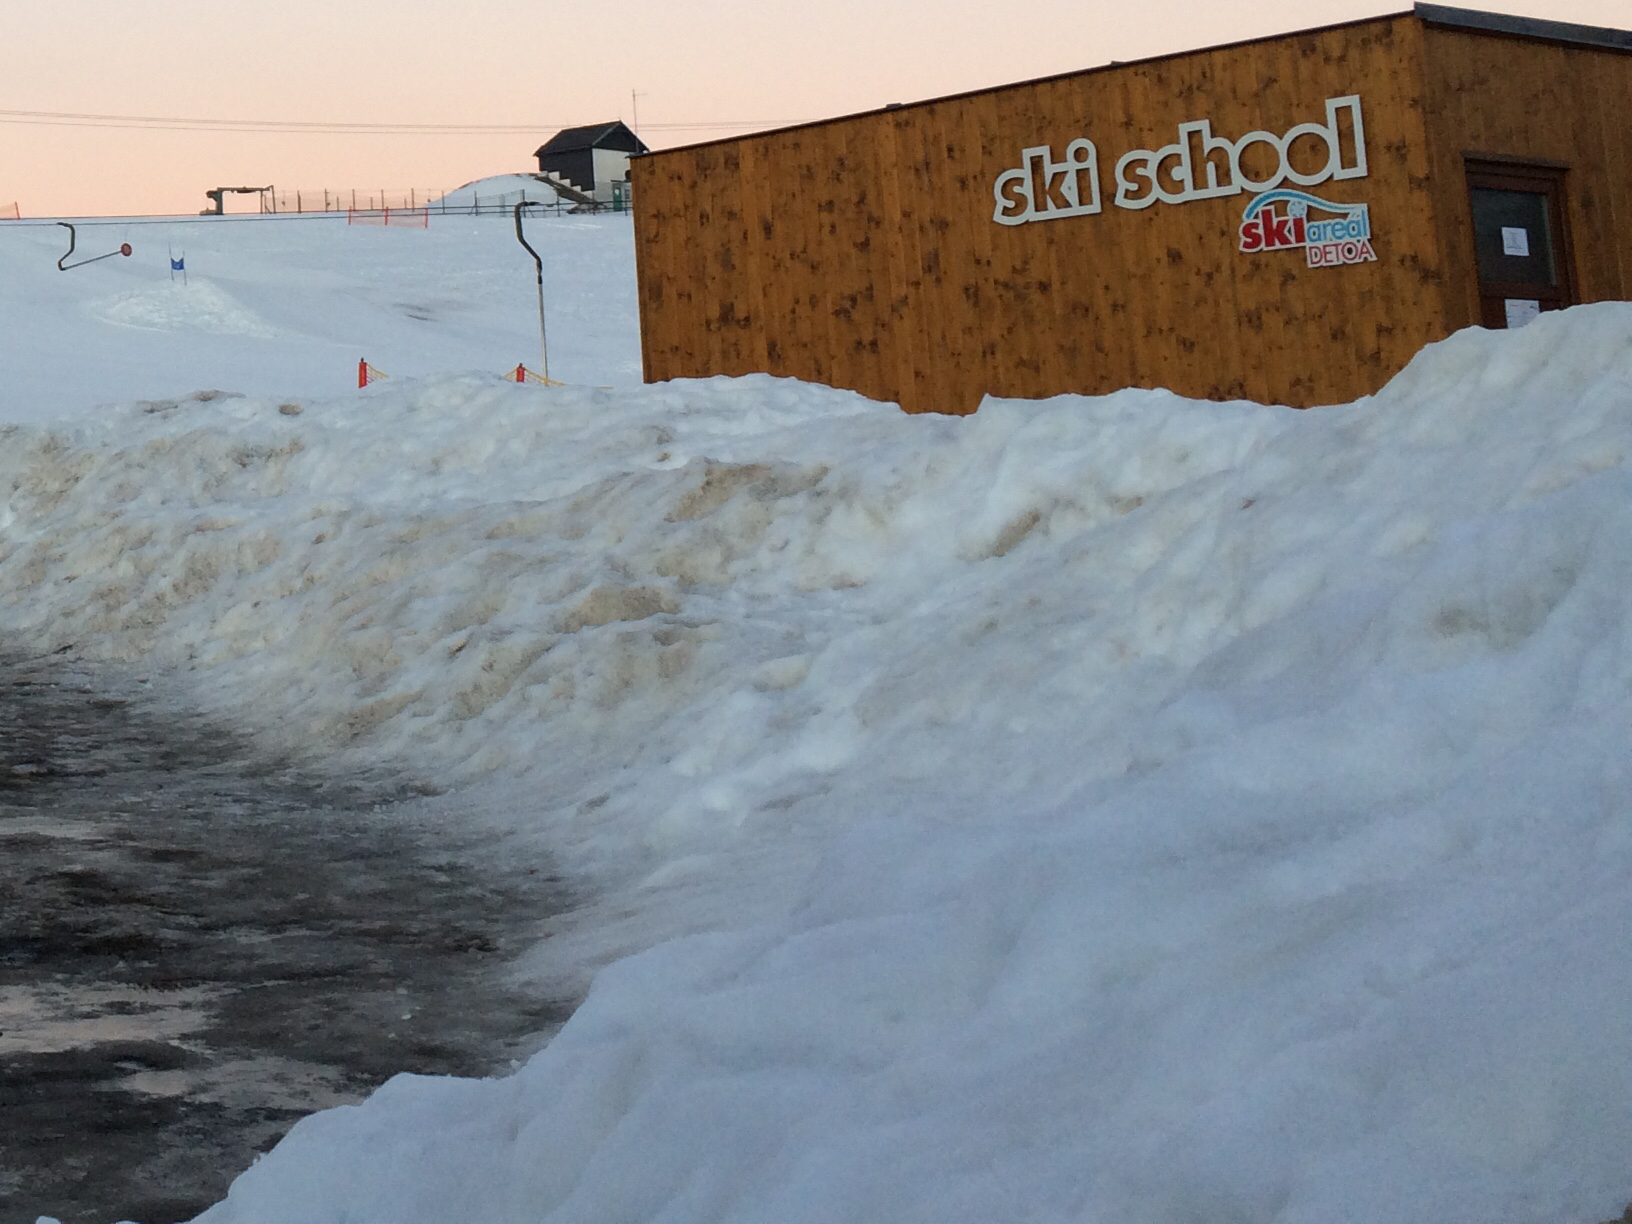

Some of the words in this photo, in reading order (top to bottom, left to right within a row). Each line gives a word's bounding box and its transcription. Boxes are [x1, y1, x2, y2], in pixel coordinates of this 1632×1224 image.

[993, 138, 1101, 225] ski
[1115, 94, 1367, 209] school
[1241, 202, 1306, 250] ski
[1308, 240, 1372, 266] DETOA
